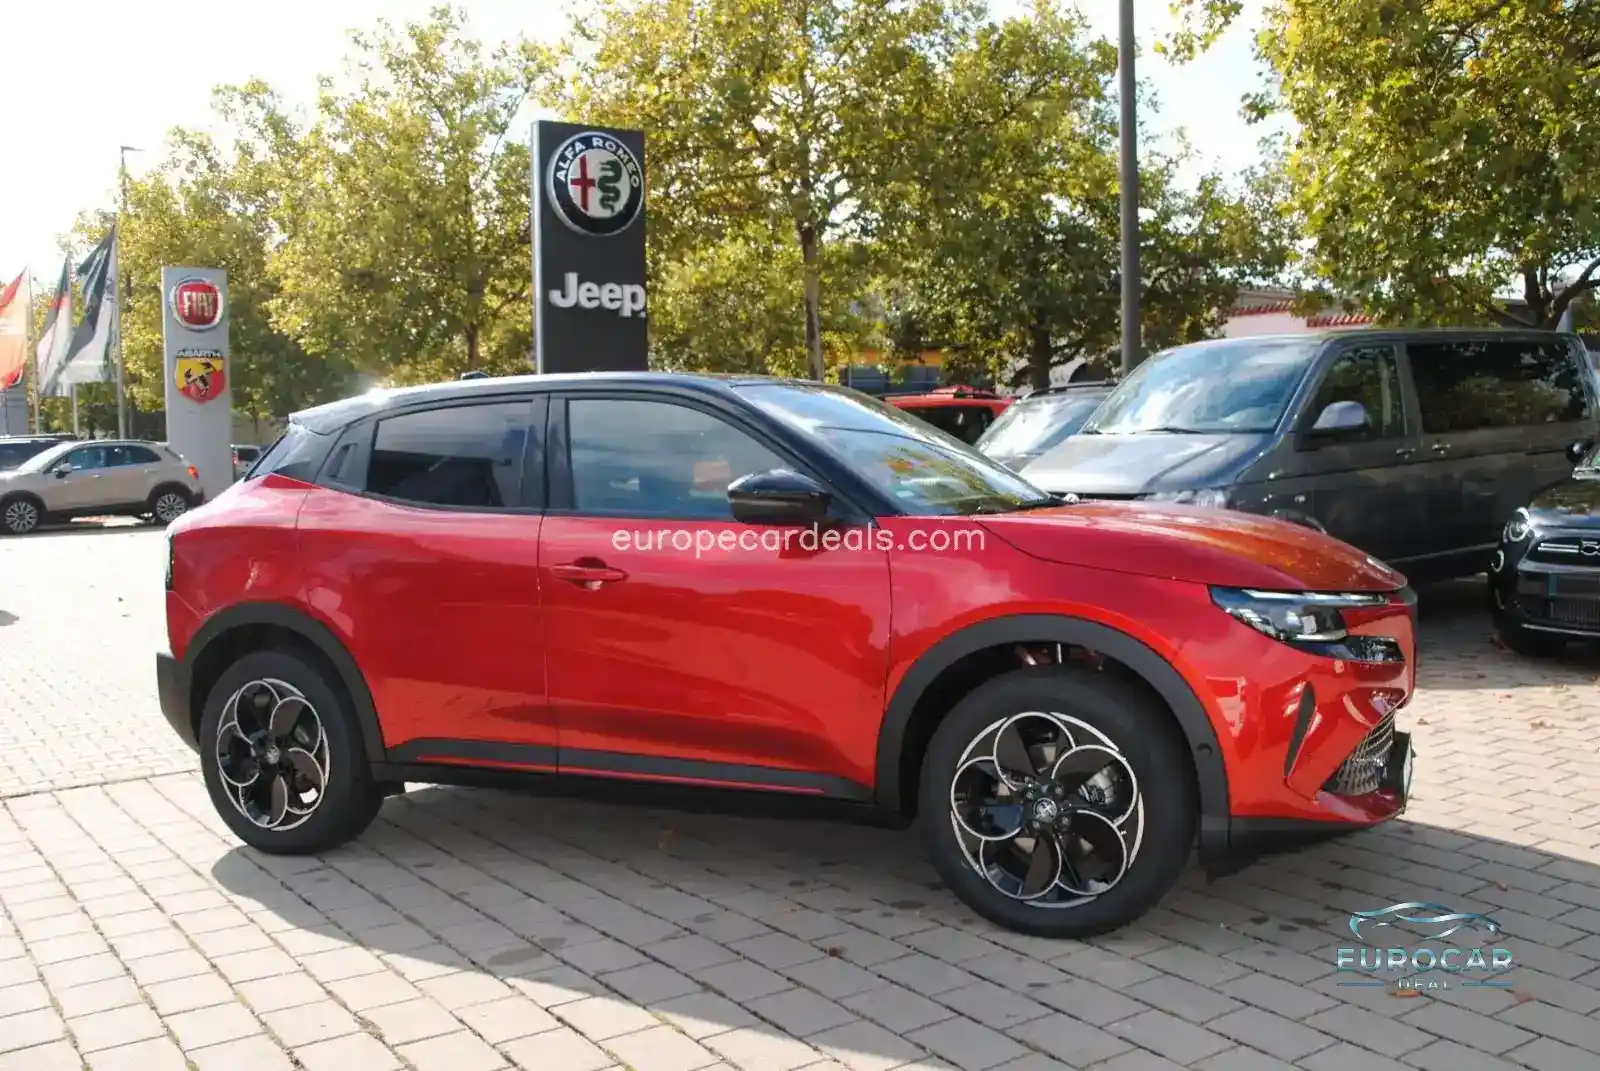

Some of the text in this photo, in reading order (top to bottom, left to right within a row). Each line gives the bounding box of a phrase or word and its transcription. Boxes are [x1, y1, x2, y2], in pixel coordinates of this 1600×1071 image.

[556, 136, 641, 188] ALFA ROMEO
[183, 291, 215, 317] FIAT
[176, 350, 222, 358] ABARTH
